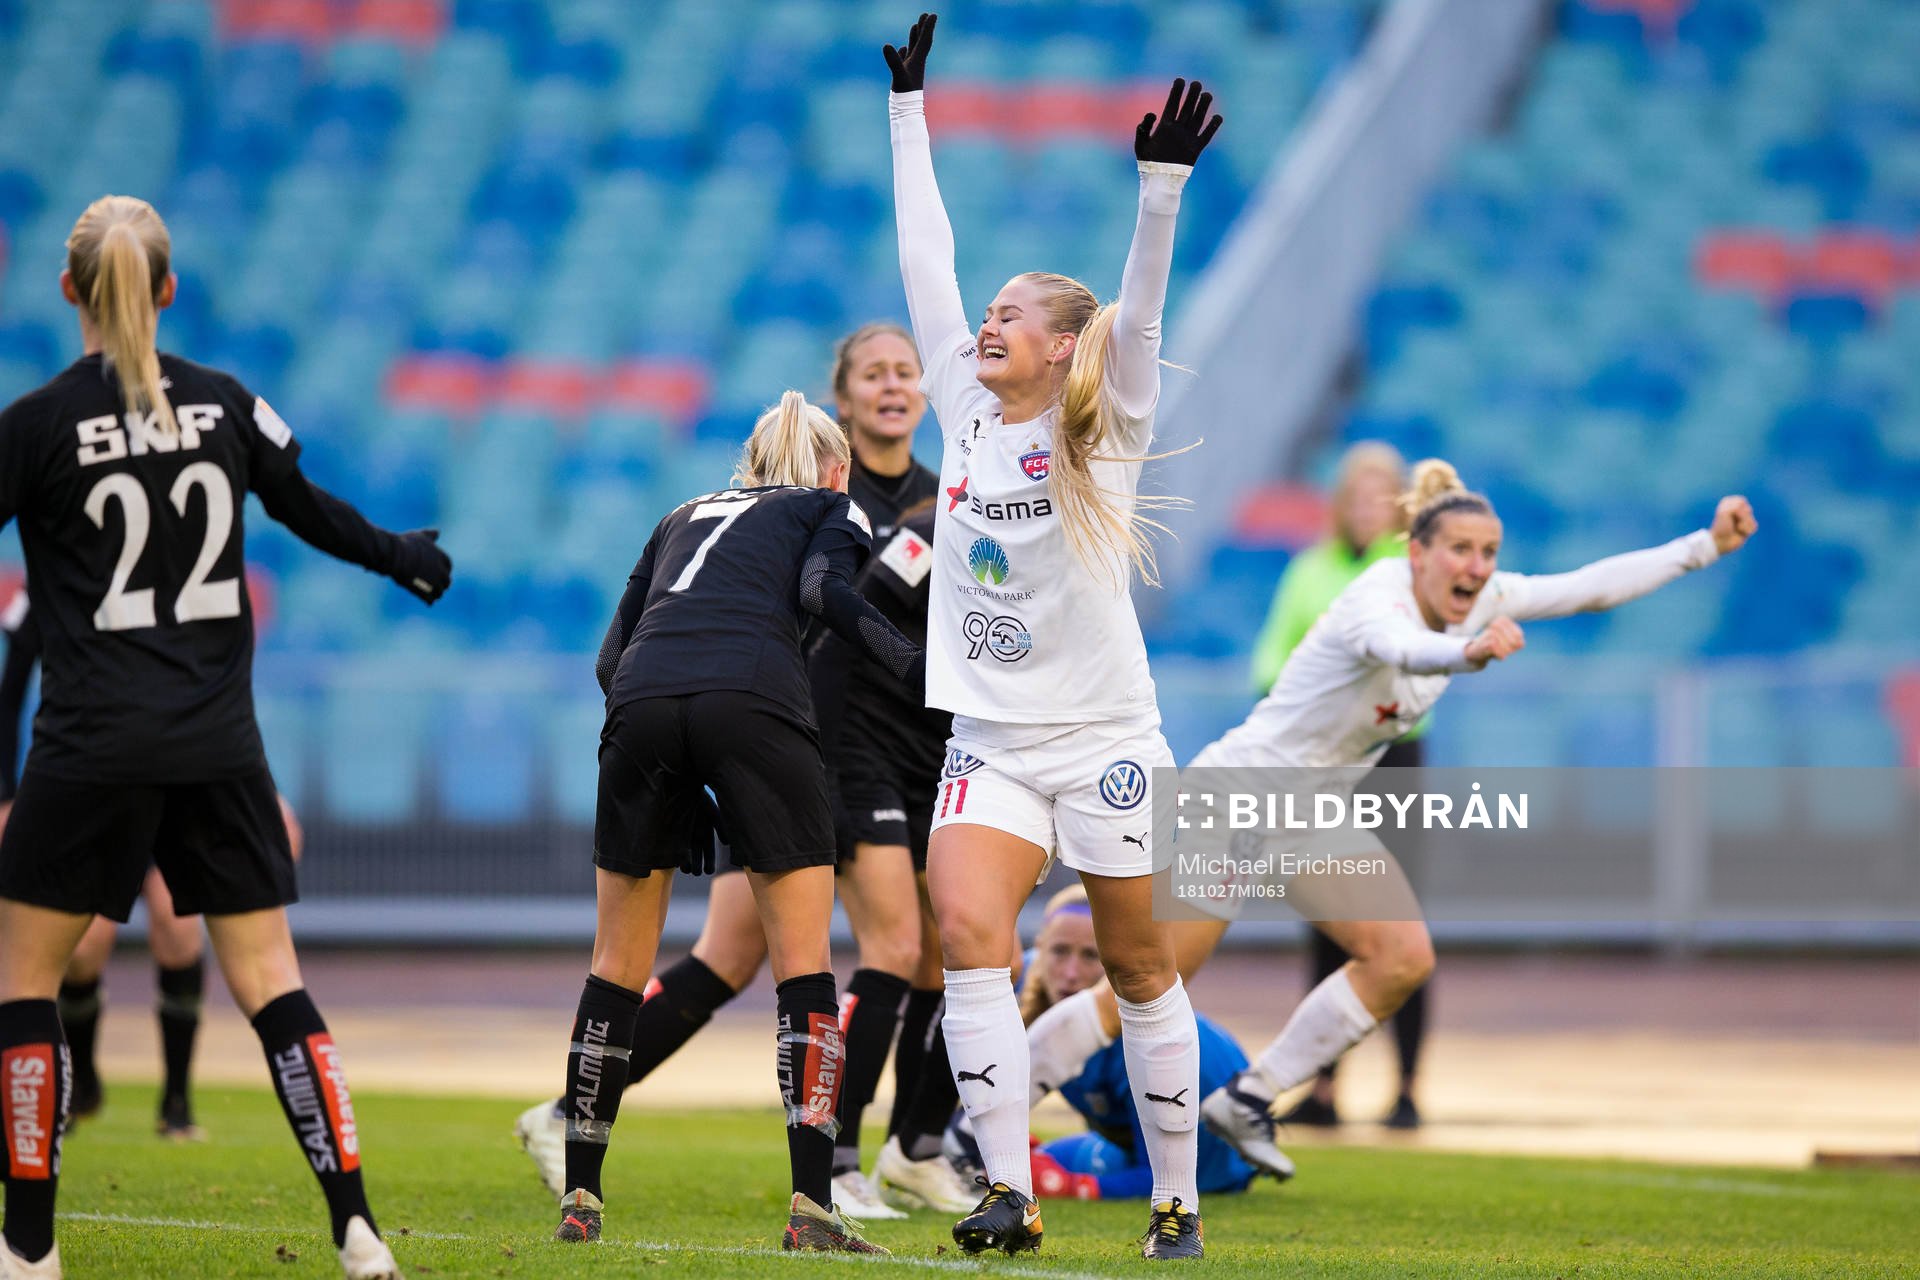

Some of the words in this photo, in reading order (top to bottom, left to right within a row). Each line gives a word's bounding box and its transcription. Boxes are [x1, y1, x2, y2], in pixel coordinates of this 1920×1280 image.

[960, 346, 977, 359] SPEL
[76, 404, 224, 466] SKF
[1025, 457, 1050, 469] FCR
[84, 461, 241, 631] 22
[669, 497, 759, 592] 7
[957, 585, 1001, 600] VICTORIA
[962, 611, 1032, 662] 90
[1016, 632, 1031, 641] 1928
[1017, 641, 1033, 650] 2018
[941, 779, 969, 818] 11
[809, 1022, 841, 1113] Stavdal
[10, 1057, 47, 1167] Stavdal
[274, 1042, 339, 1173] SALMING
